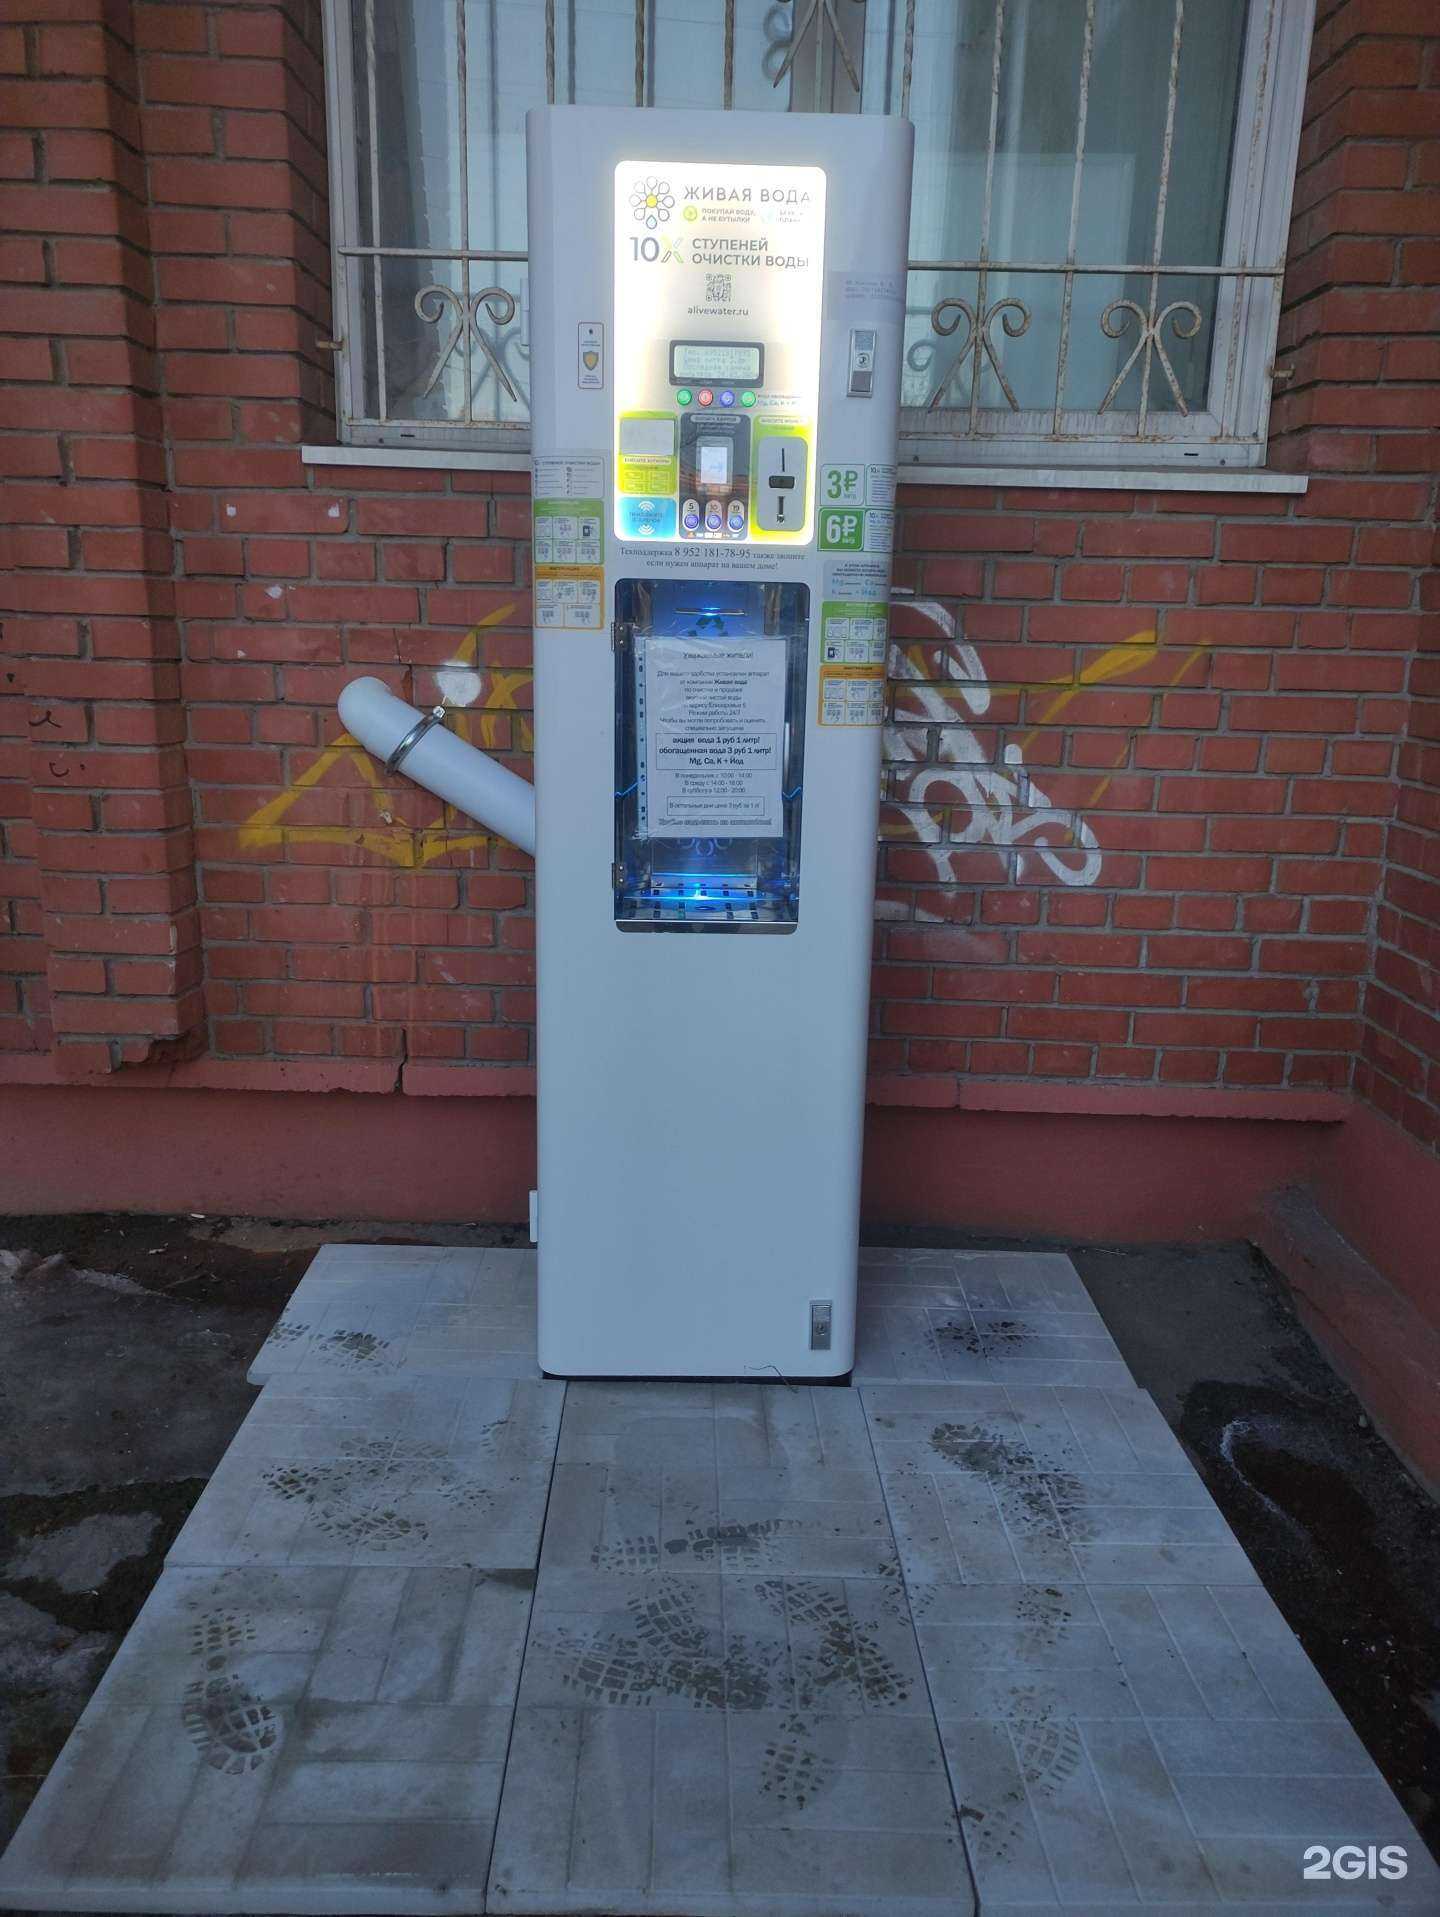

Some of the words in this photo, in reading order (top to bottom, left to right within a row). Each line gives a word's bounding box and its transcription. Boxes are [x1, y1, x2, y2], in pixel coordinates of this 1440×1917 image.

[684, 186, 752, 202] ЖИВАЯ
[760, 189, 811, 205] ВОДА
[692, 237, 769, 252] СТУПЕНЕЙ
[692, 253, 761, 267] ОЧИСТКИ
[765, 255, 810, 270] ВОДЫ
[687, 305, 749, 317] alivewater.ru
[688, 502, 695, 510] 5
[674, 547, 681, 557] 8
[681, 547, 701, 558] 952
[704, 548, 751, 559] 181-78-95
[722, 736, 735, 745] руб
[734, 747, 747, 755] руб
